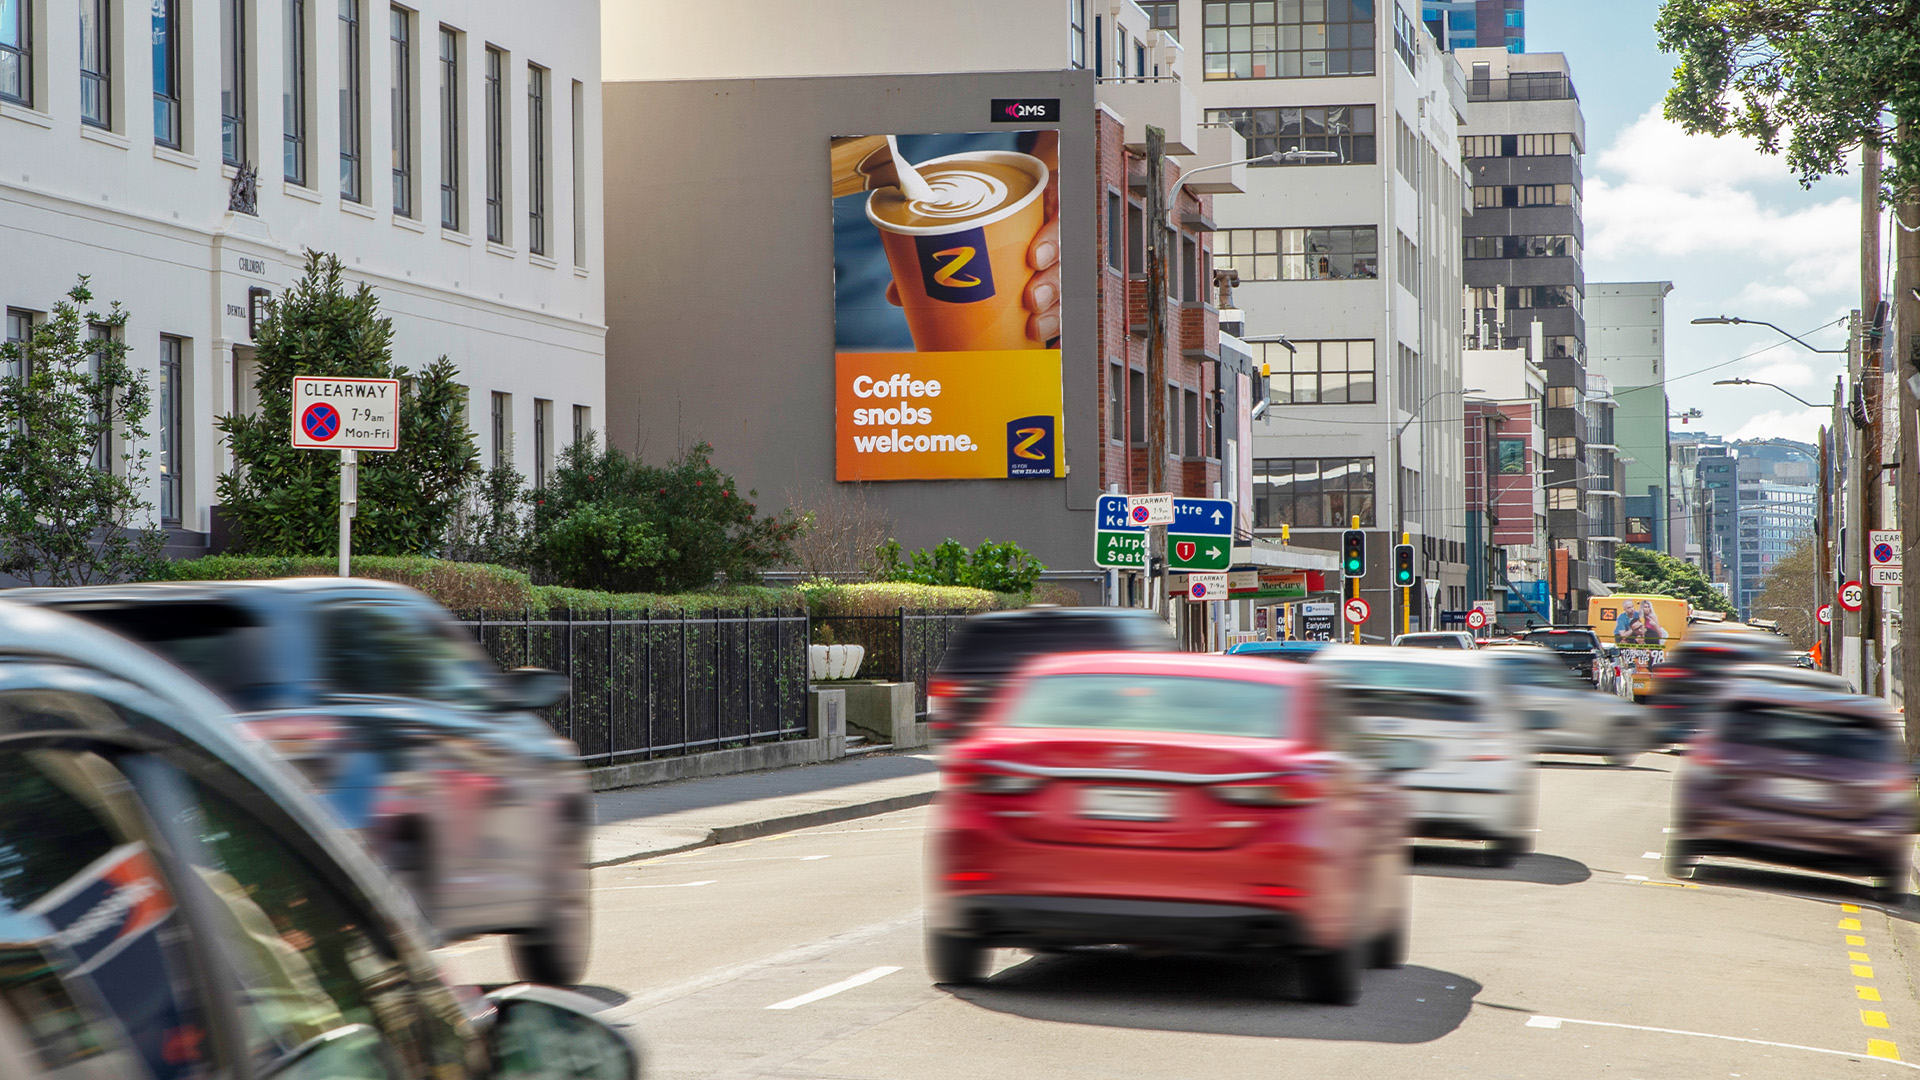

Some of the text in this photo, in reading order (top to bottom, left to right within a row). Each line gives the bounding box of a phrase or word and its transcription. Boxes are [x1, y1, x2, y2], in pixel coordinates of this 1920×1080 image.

[1012, 103, 1046, 118] QMS
[227, 303, 246, 318] DENTAL
[305, 383, 387, 398] CLEARWAY
[853, 373, 941, 398] Coffee
[352, 408, 384, 422] 7-9am
[853, 401, 932, 426] snobs
[345, 428, 390, 439] Mon-Fri
[853, 428, 978, 453] welcome.
[1132, 497, 1168, 505] CLEARWAY
[1874, 534, 1902, 542] CLEAR
[1184, 545, 1189, 556] 1
[1845, 591, 1861, 602] 50
[1470, 615, 1482, 624] 30
[1602, 609, 1614, 619] 25
[1306, 621, 1331, 631] Earlybird
